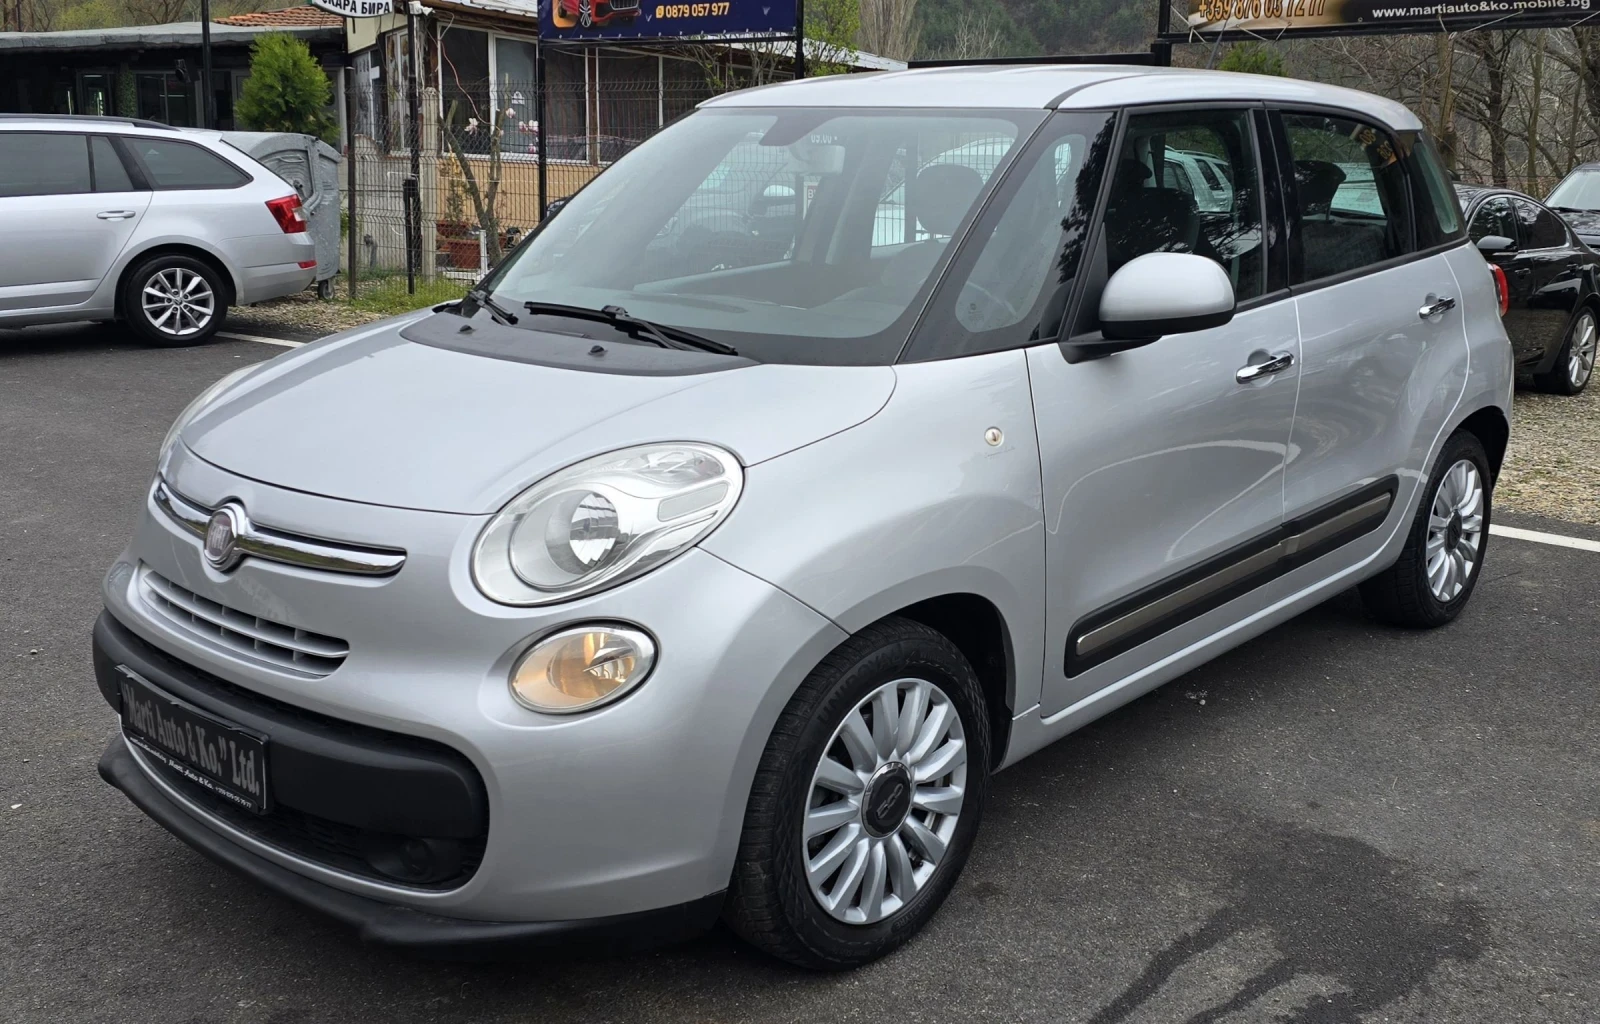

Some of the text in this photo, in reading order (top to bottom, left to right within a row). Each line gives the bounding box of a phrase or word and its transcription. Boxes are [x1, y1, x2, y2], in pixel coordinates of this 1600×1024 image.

[322, 0, 390, 15] КАРА БИРА
[665, 2, 730, 18] 0879 057 977
[1198, 0, 1232, 21] +359
[1235, 0, 1261, 19] 876
[1264, 0, 1283, 18] 03
[1372, 0, 1591, 18] www.martiauto&ko.mobile.bg
[156, 704, 187, 757] Auto
[185, 721, 198, 763] &
[229, 740, 260, 797] Ltd.
